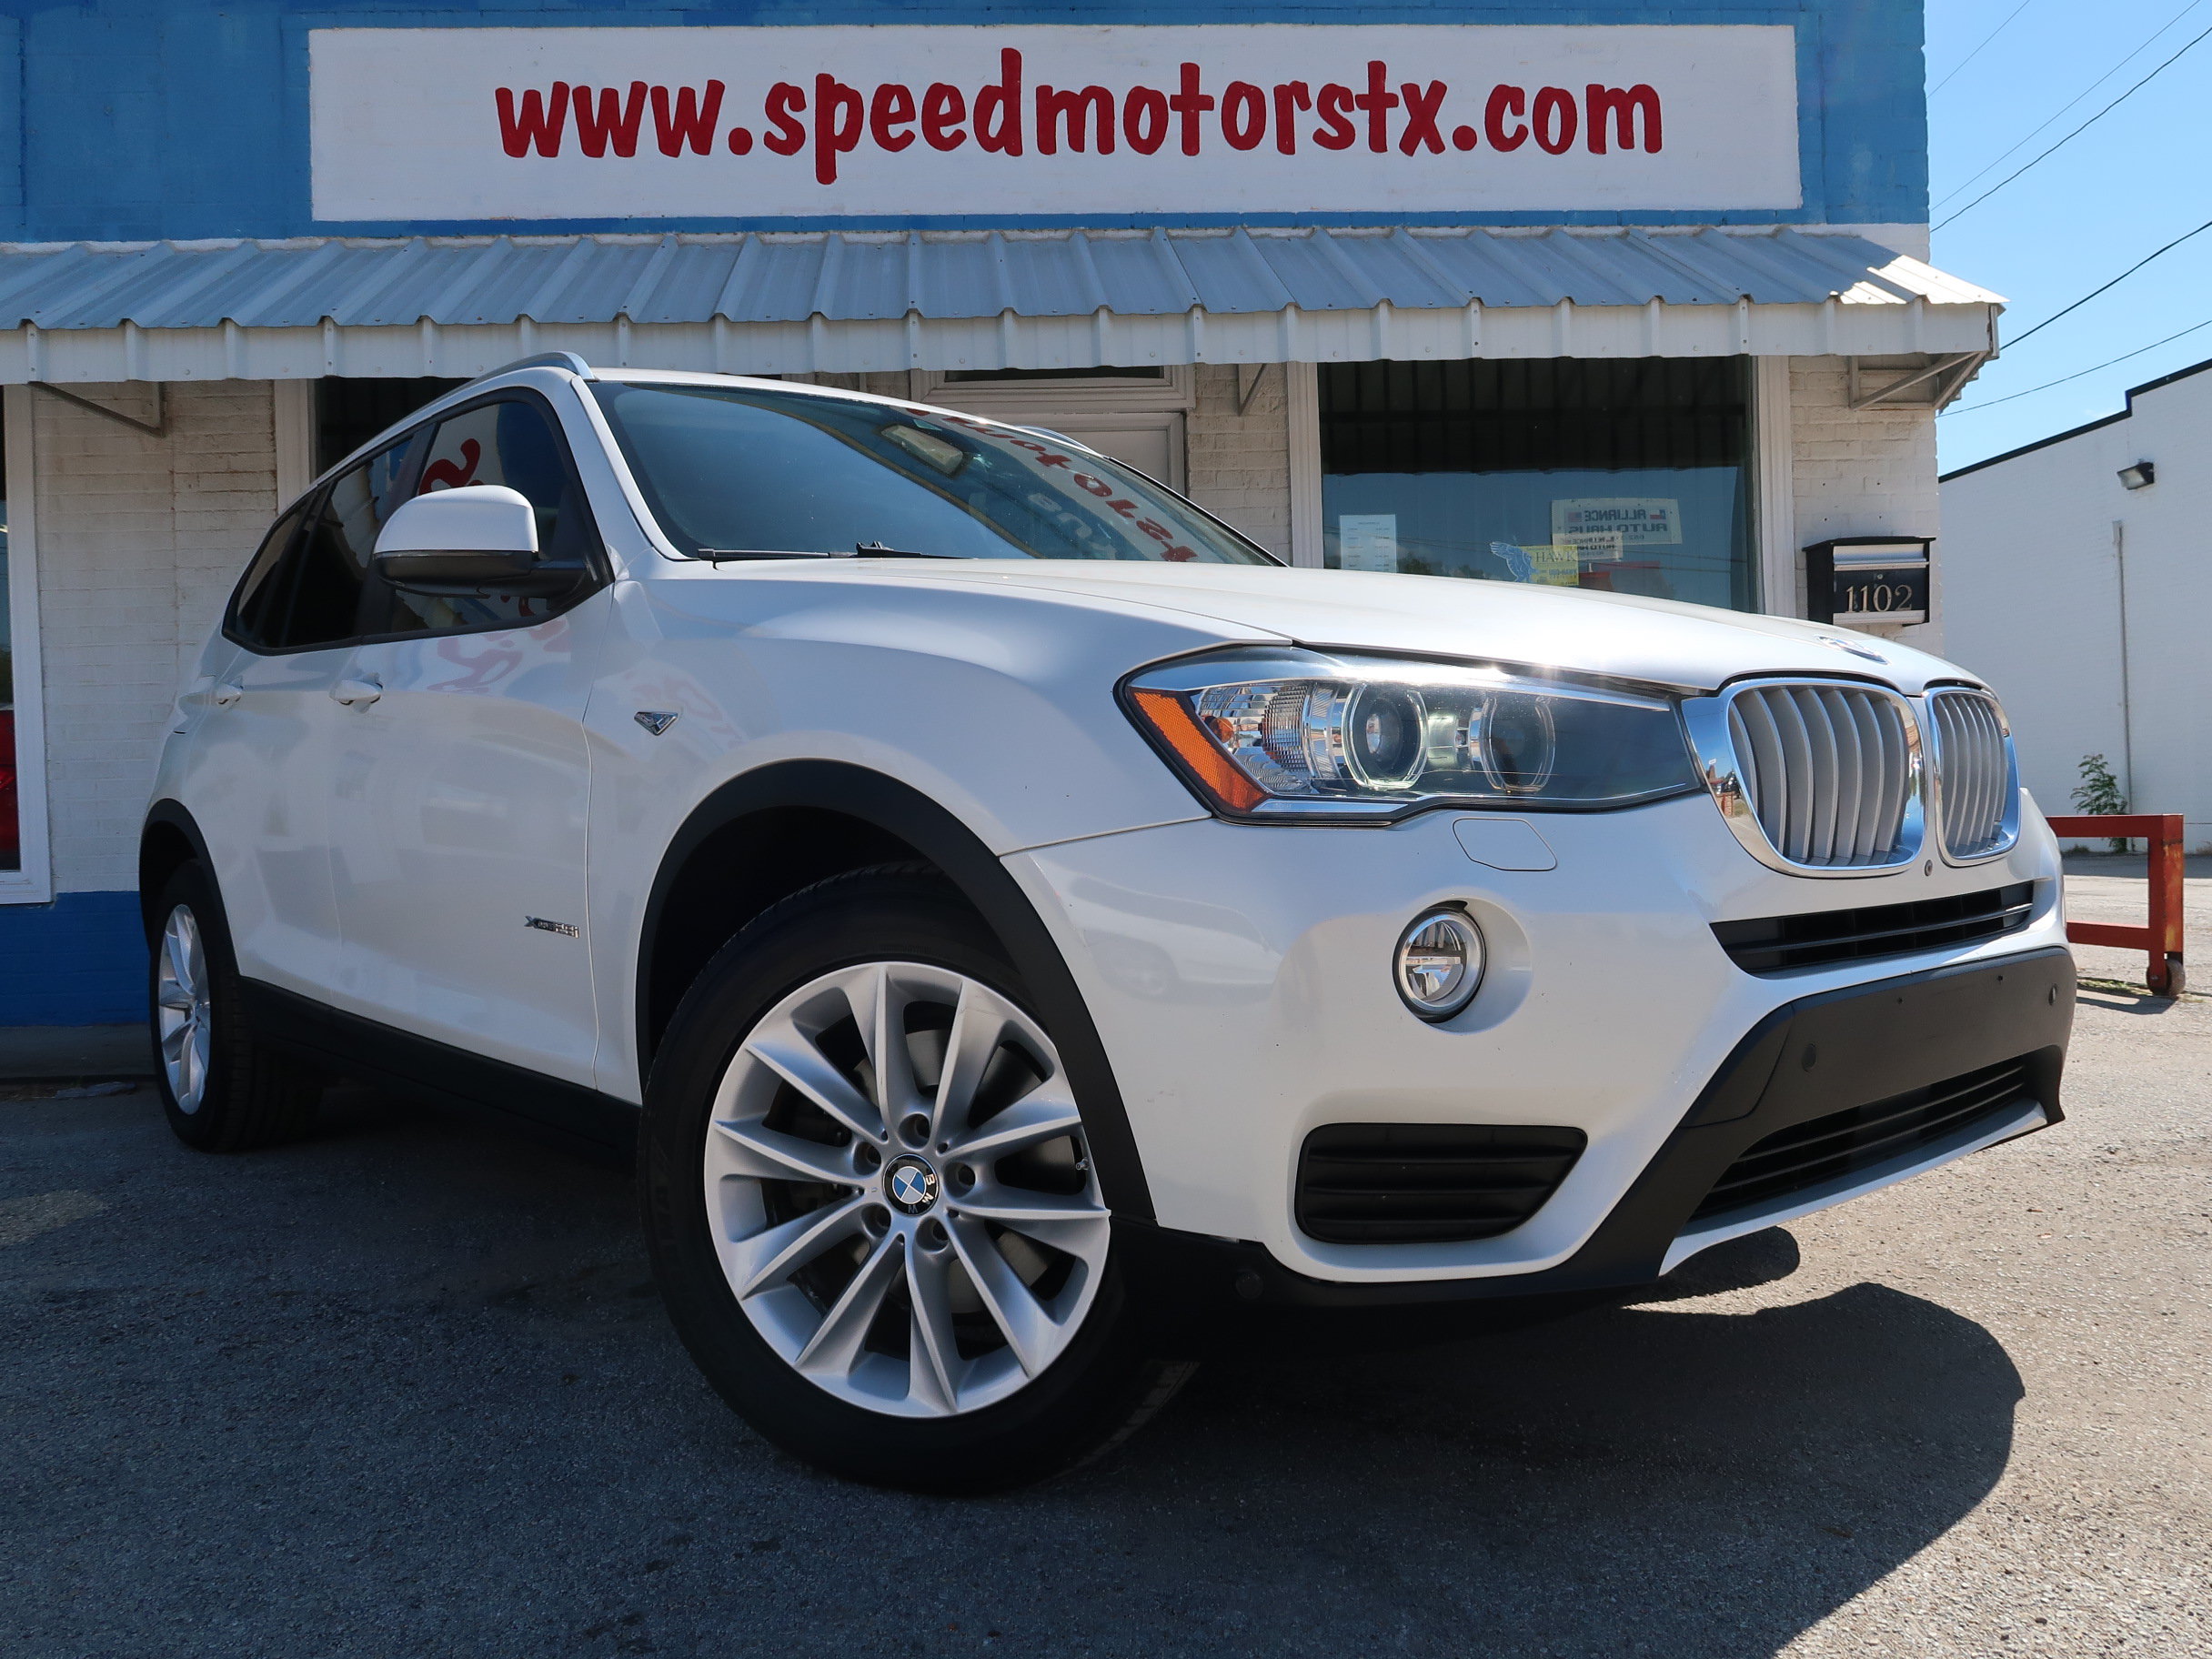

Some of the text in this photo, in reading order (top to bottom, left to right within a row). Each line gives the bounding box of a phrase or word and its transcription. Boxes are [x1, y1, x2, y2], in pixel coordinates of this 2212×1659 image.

[495, 47, 1663, 185] www.speedmotorstx.com
[1535, 551, 1578, 563] HAWK
[1845, 584, 1913, 614] 1102
[908, 1173, 936, 1214] BMW
